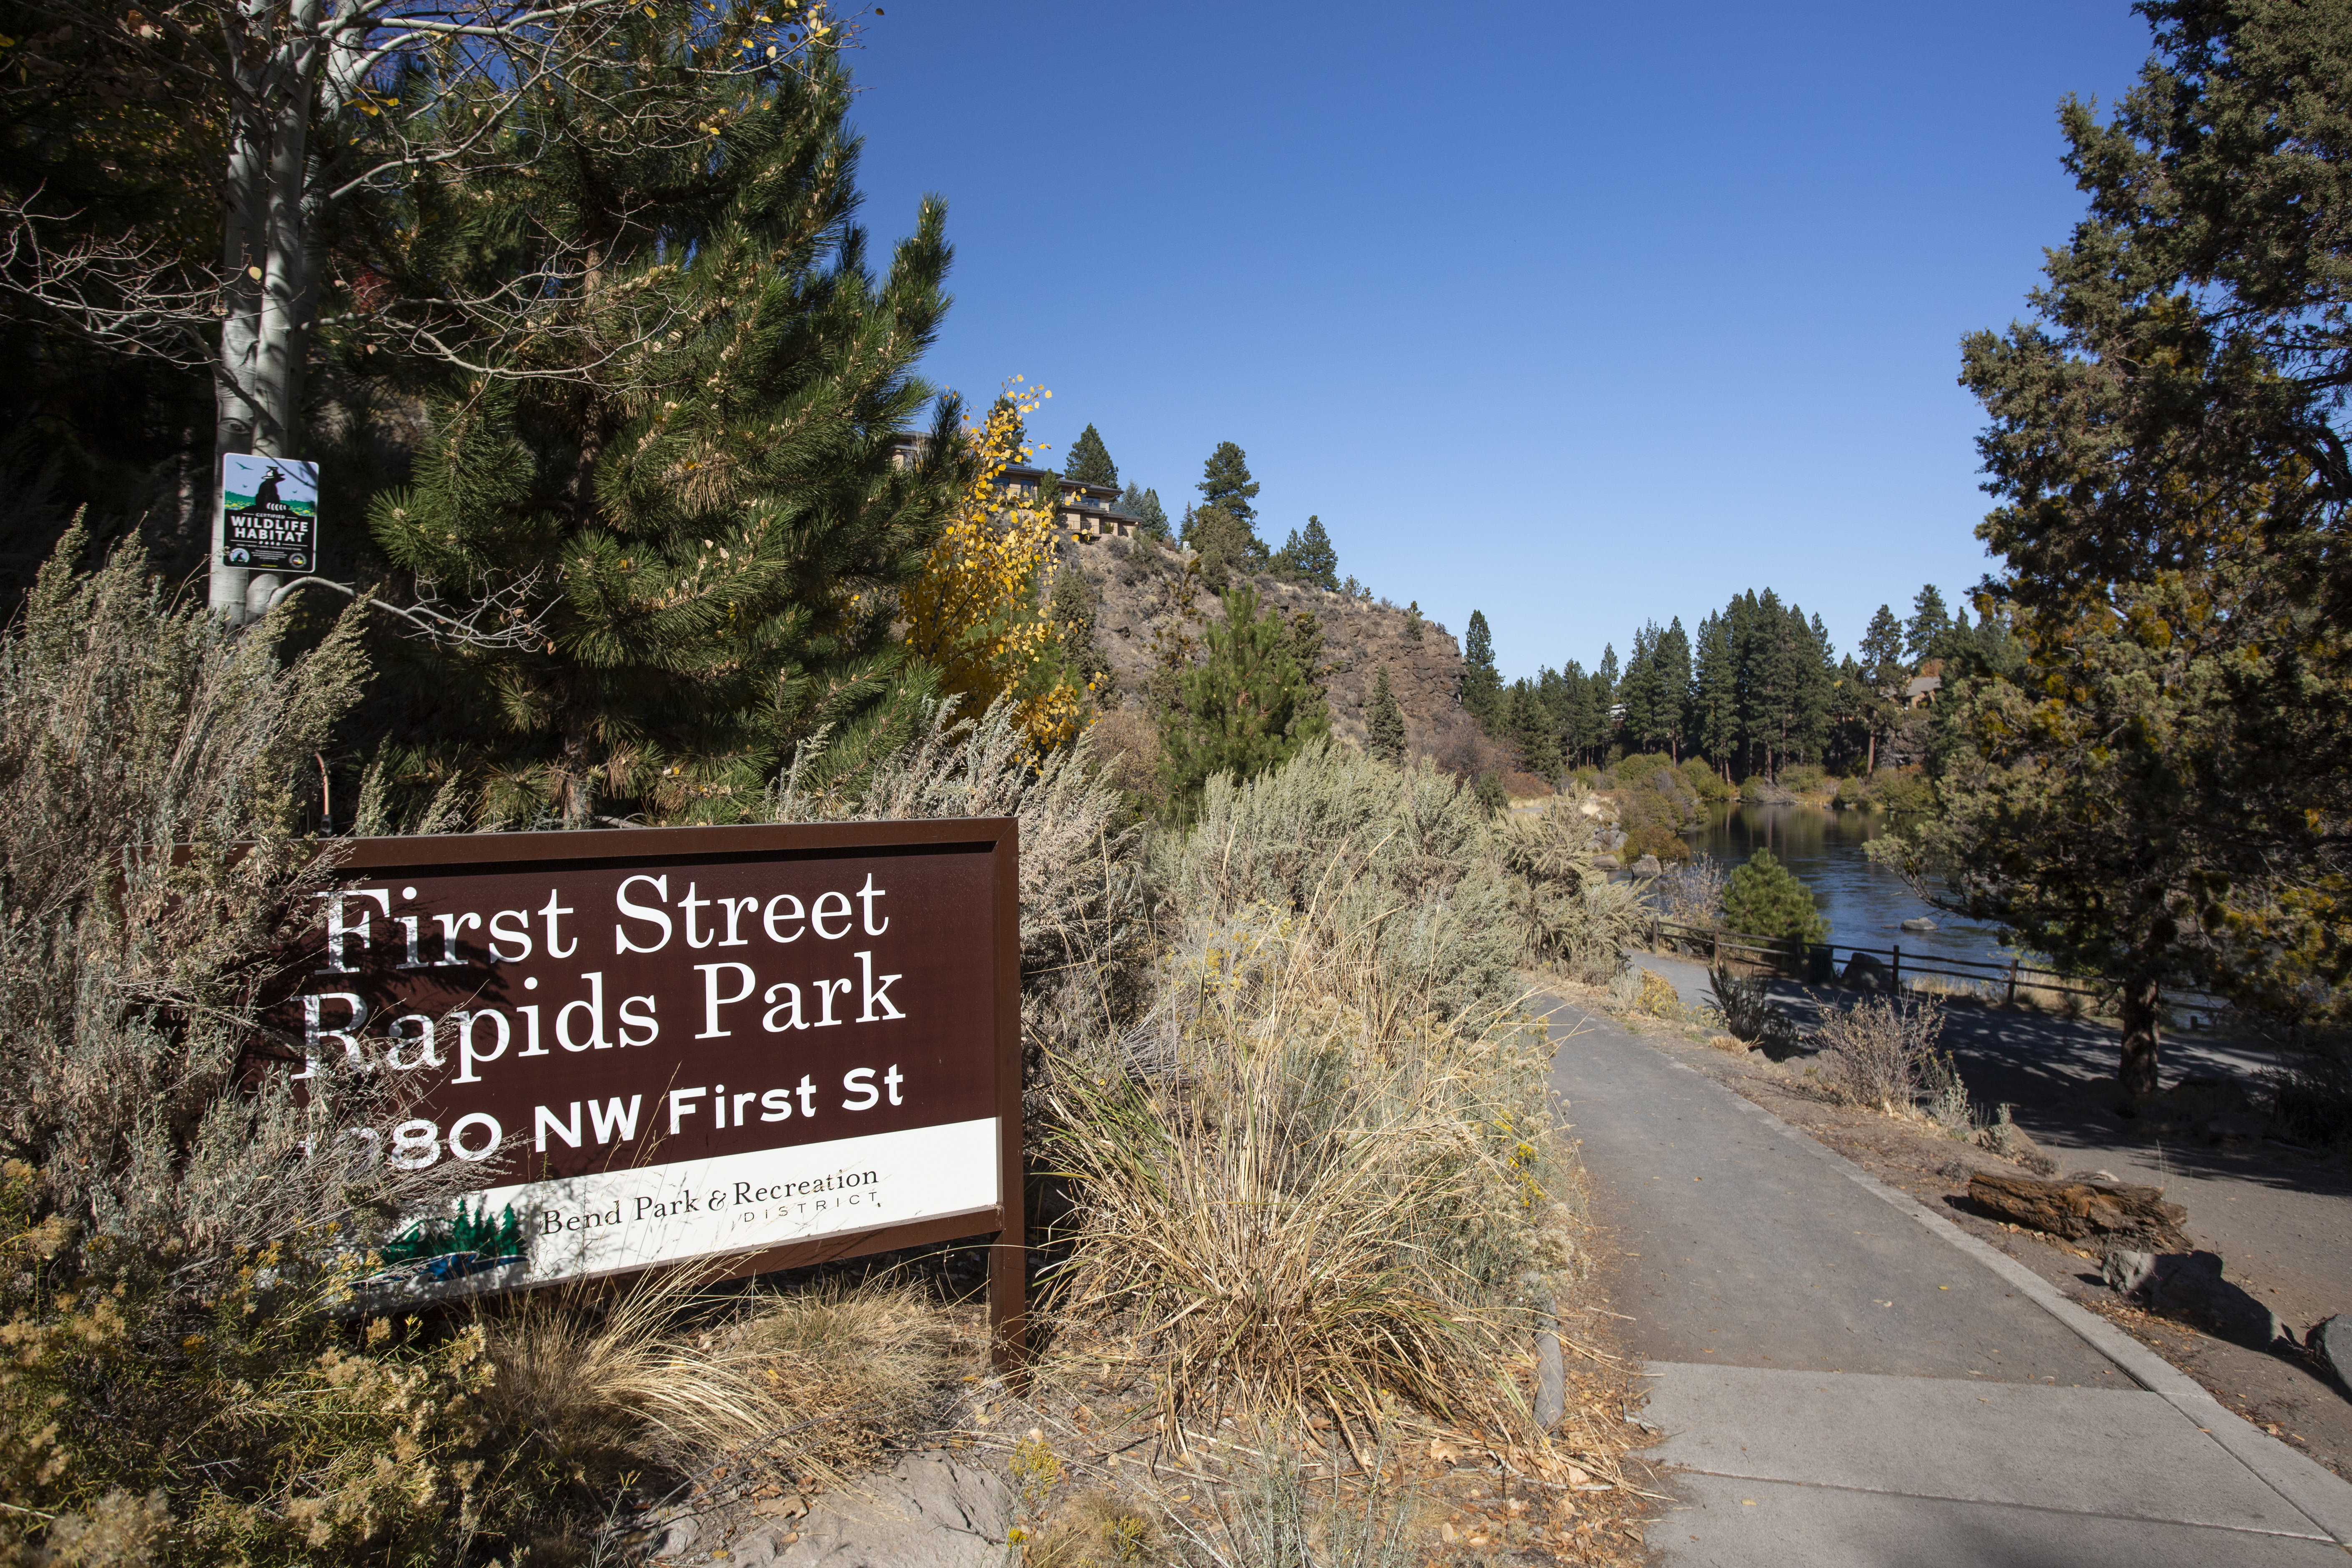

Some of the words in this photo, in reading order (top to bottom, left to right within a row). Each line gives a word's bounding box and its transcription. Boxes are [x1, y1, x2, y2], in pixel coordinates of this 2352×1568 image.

[231, 516, 308, 532] WILDLIFE
[234, 527, 305, 542] HABITAT
[313, 886, 577, 975] First
[616, 873, 889, 954] Street
[291, 972, 659, 1084] Rapids
[694, 951, 906, 1039] Park
[534, 1094, 642, 1153] NW
[669, 1074, 816, 1134] First
[842, 1064, 903, 1111] St
[541, 1201, 622, 1235] Bend
[634, 1189, 700, 1221] Park
[708, 1190, 727, 1211] &
[733, 1169, 879, 1205] Recreation
[744, 1191, 877, 1223] DISTRICT
